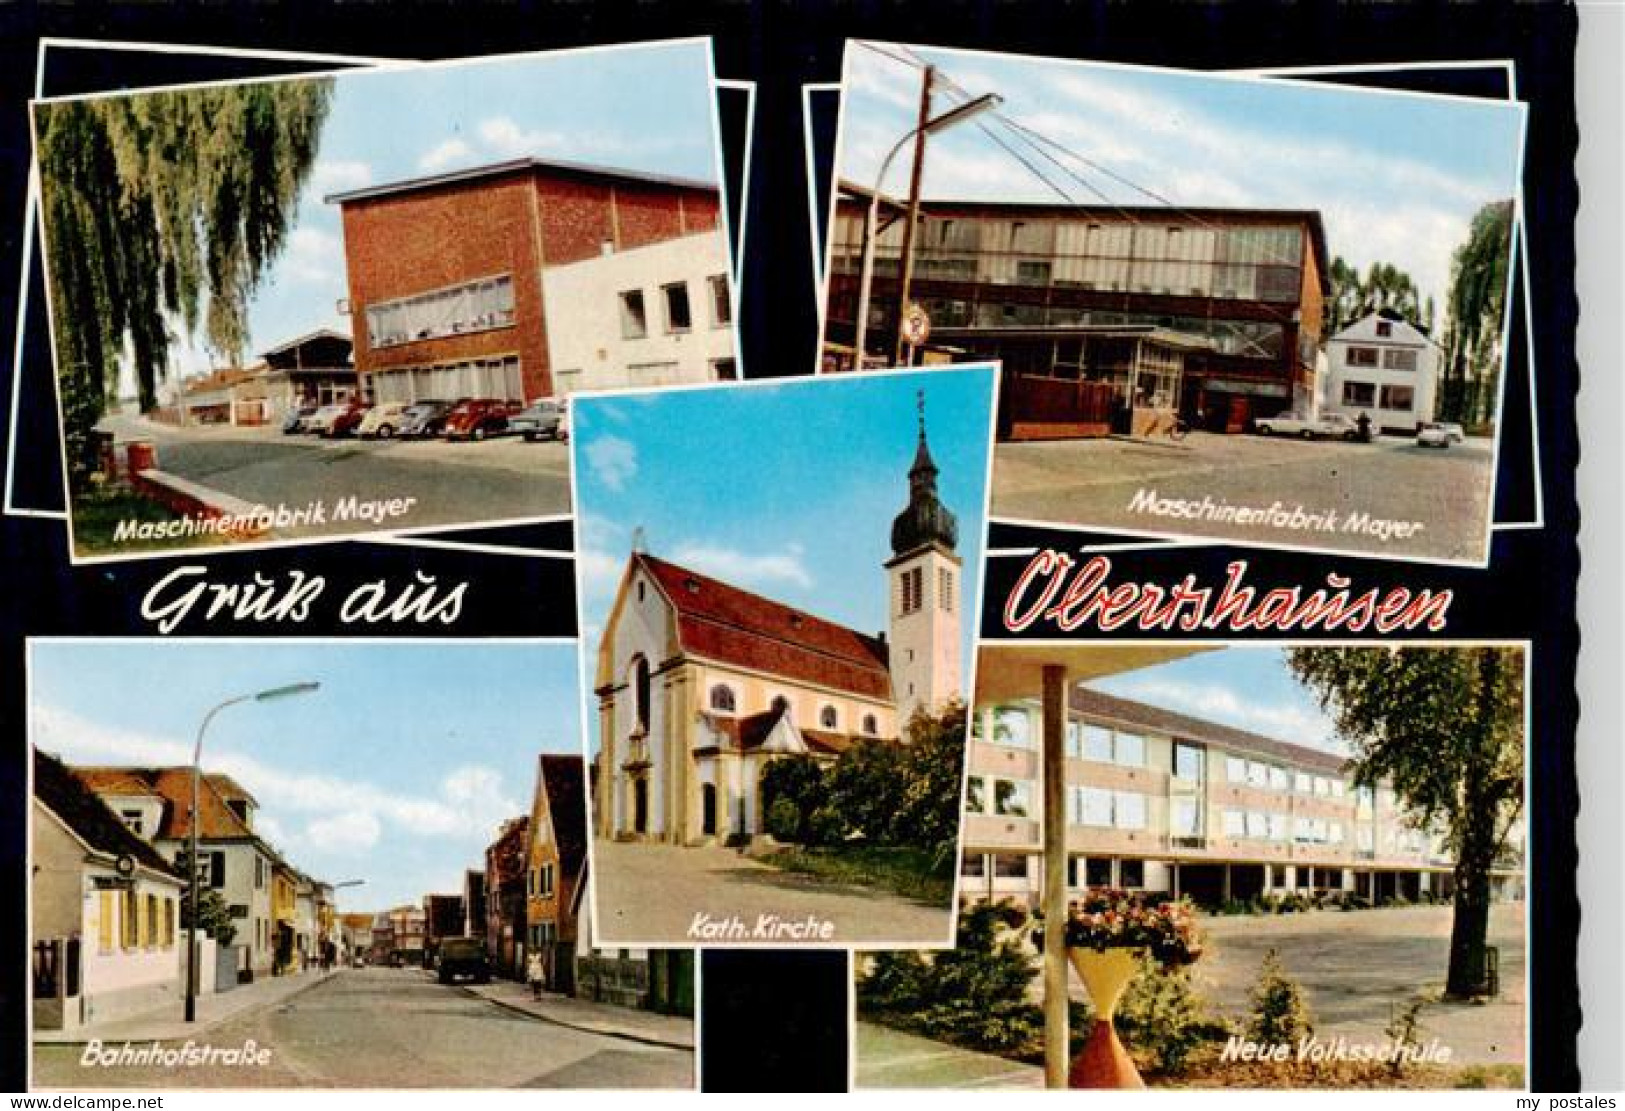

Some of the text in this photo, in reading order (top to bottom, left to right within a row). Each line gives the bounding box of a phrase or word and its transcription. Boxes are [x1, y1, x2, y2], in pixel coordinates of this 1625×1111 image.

[113, 496, 418, 542] Maschinenfabrik Mayer
[1127, 488, 1424, 542] Maschinenfabrik Mayer
[340, 569, 470, 624] aus
[1003, 548, 1454, 633] Obertshausen
[80, 1039, 272, 1067] Bahnhofstraße
[1220, 1036, 1453, 1065] Neue Volksschule
